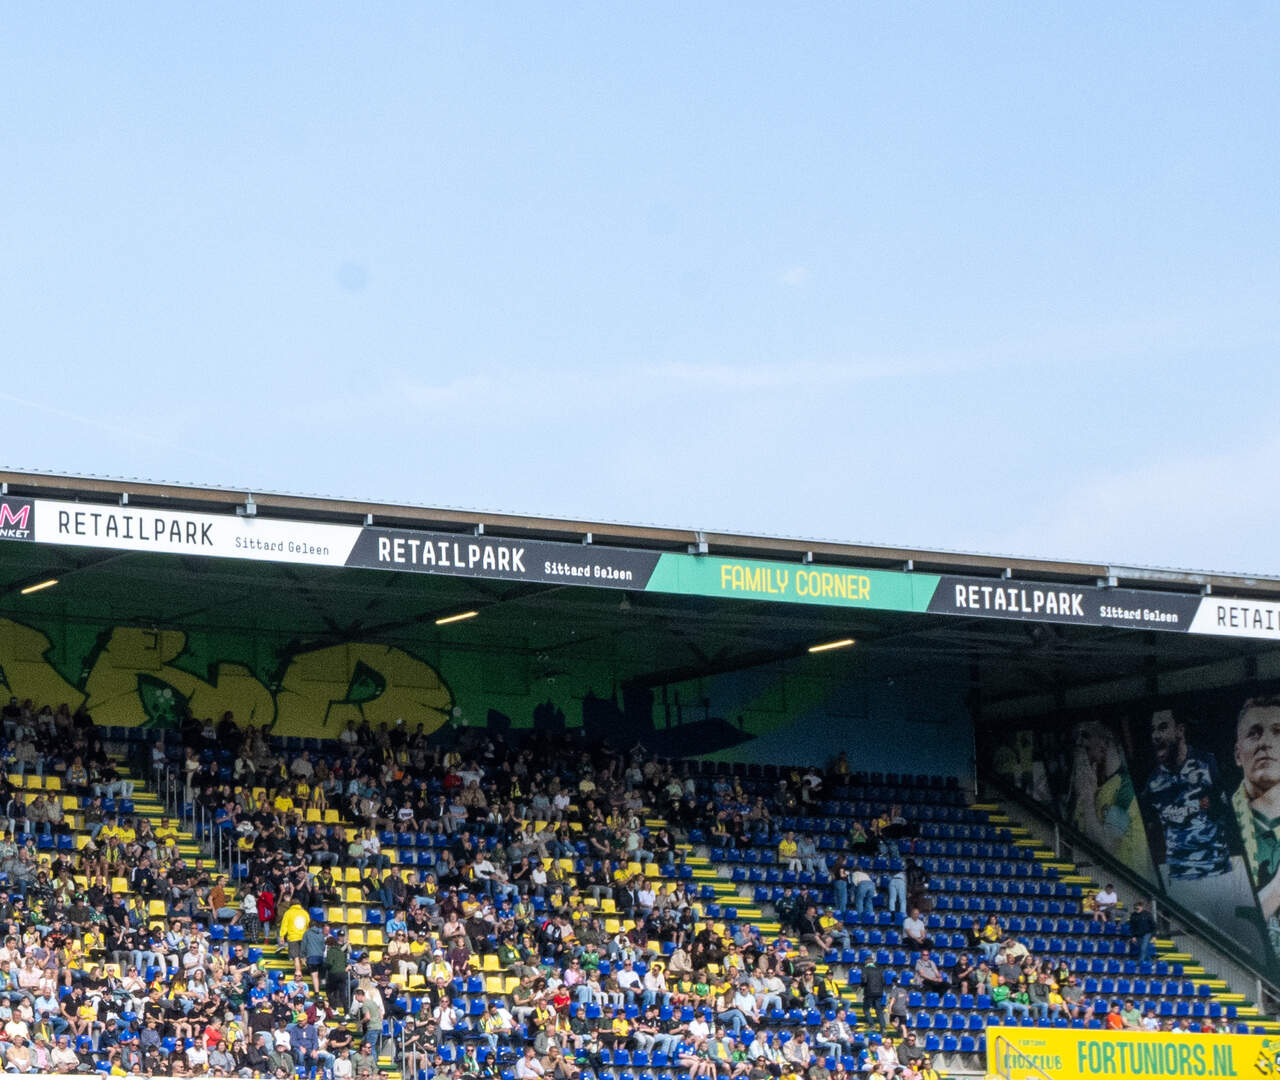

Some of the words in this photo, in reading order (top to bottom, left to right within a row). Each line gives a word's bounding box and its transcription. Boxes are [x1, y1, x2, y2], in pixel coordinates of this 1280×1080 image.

[58, 510, 214, 546] RETAILPARK
[235, 536, 284, 551] Sittard
[288, 540, 330, 556] Geleen
[378, 536, 526, 573] RETAILPARK
[544, 561, 591, 577] Sittard
[594, 564, 633, 581] Geleen
[720, 564, 789, 594] FAMILY
[795, 570, 871, 600] CORNER
[954, 583, 1084, 617] RETAILPARK
[1099, 605, 1142, 620] Sittard
[1143, 608, 1179, 623] Geleen
[1217, 605, 1280, 631] RETAI
[1077, 1040, 1238, 1077] FORTUNIORS.NL
